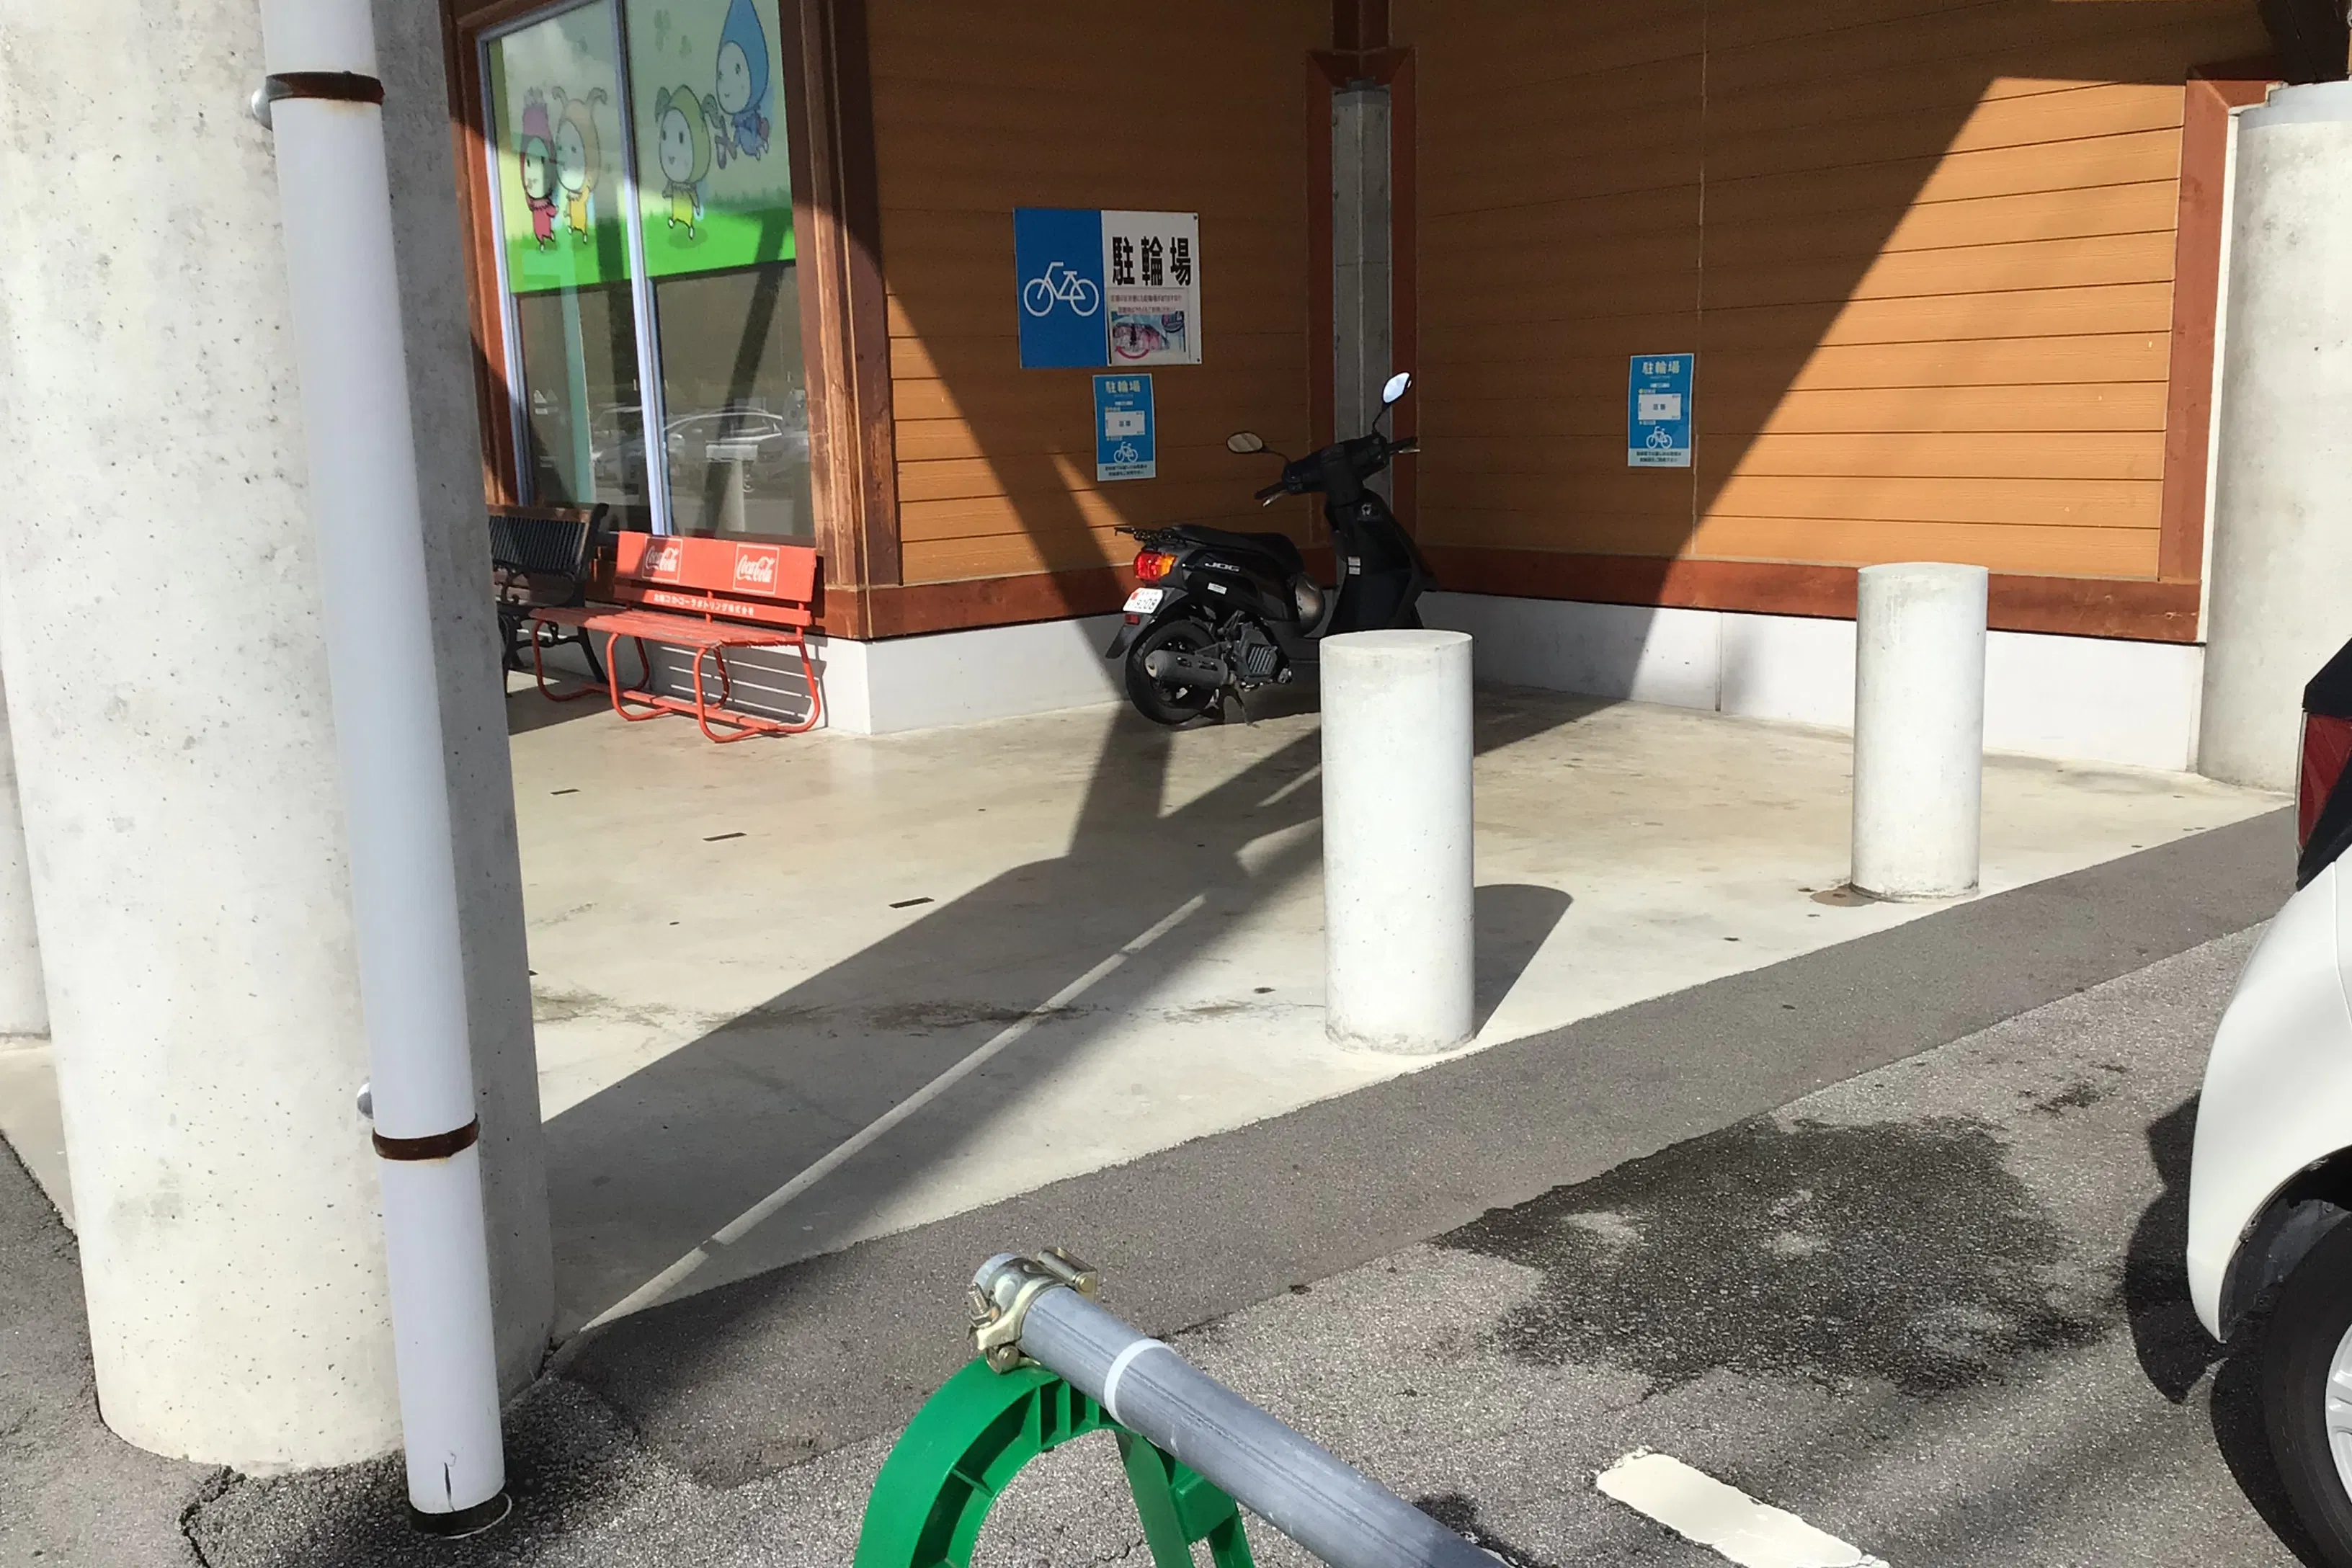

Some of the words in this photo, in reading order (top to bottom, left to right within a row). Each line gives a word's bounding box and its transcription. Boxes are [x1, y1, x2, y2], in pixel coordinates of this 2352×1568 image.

[1112, 236, 1191, 286] 駐輪場
[1642, 360, 1680, 375] 駐輪場
[1105, 380, 1141, 393] 駐輪場
[645, 545, 680, 571] Coca-Cola
[1204, 561, 1240, 572] JOG
[736, 554, 775, 583] Coca-Cola
